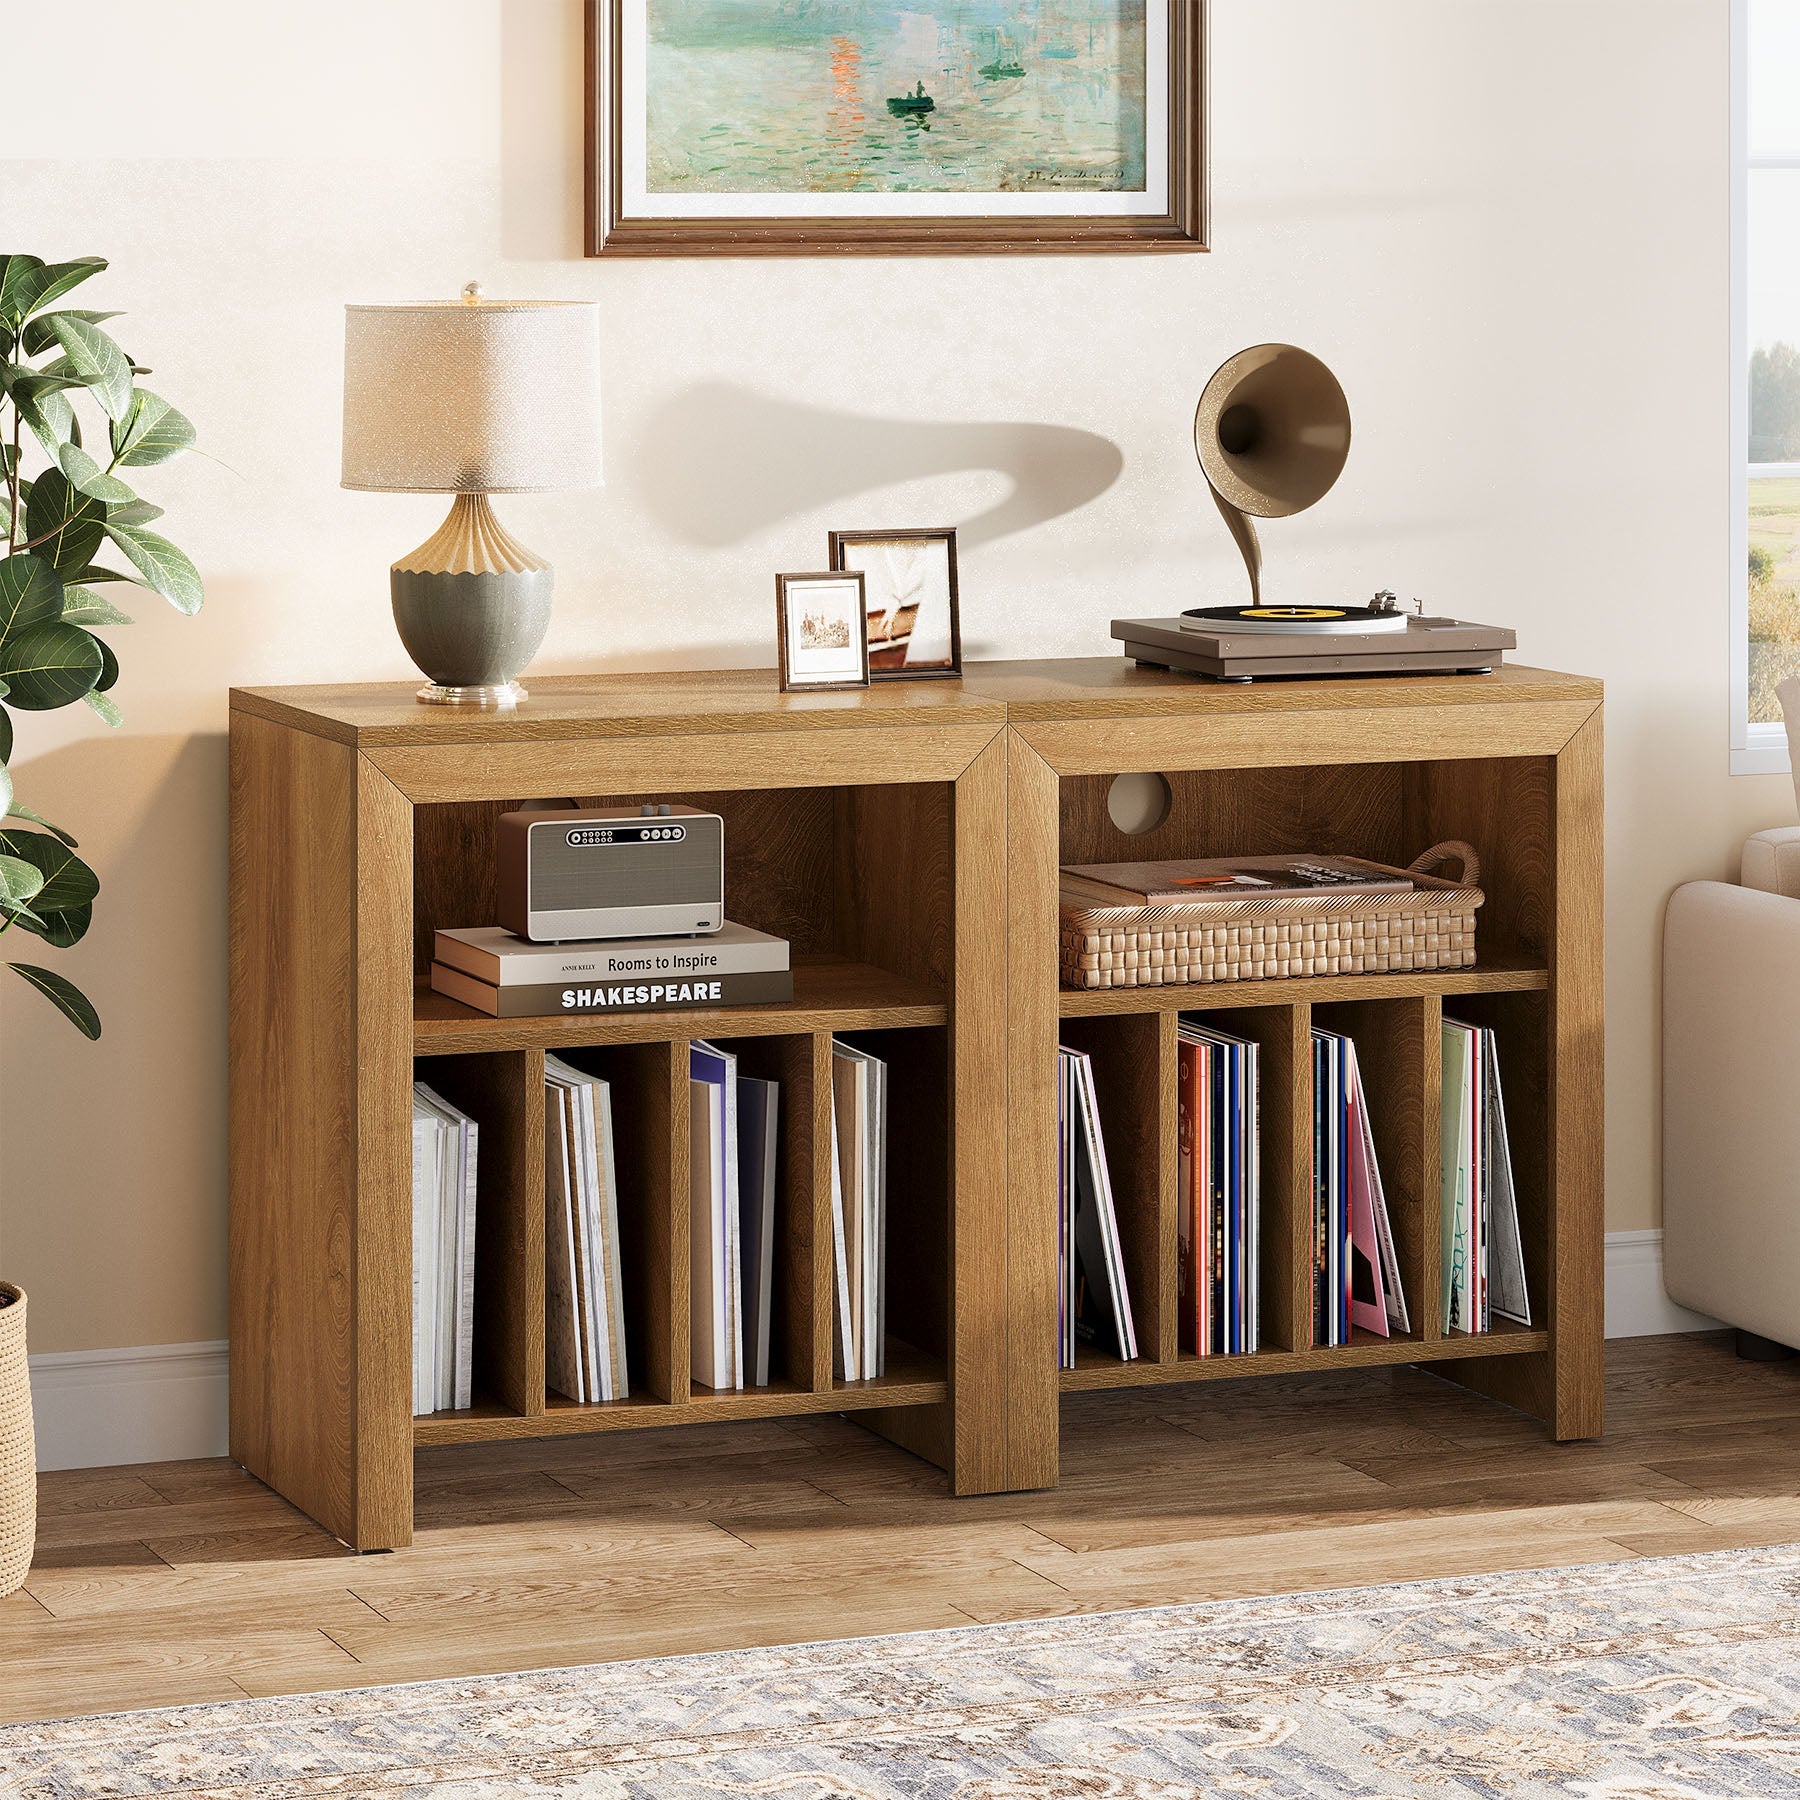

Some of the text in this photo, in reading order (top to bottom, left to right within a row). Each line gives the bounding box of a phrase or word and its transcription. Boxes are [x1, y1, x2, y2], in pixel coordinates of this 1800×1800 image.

[608, 953, 718, 972] Rooms to Inspire
[561, 981, 722, 1008] SHAKESPEARE
